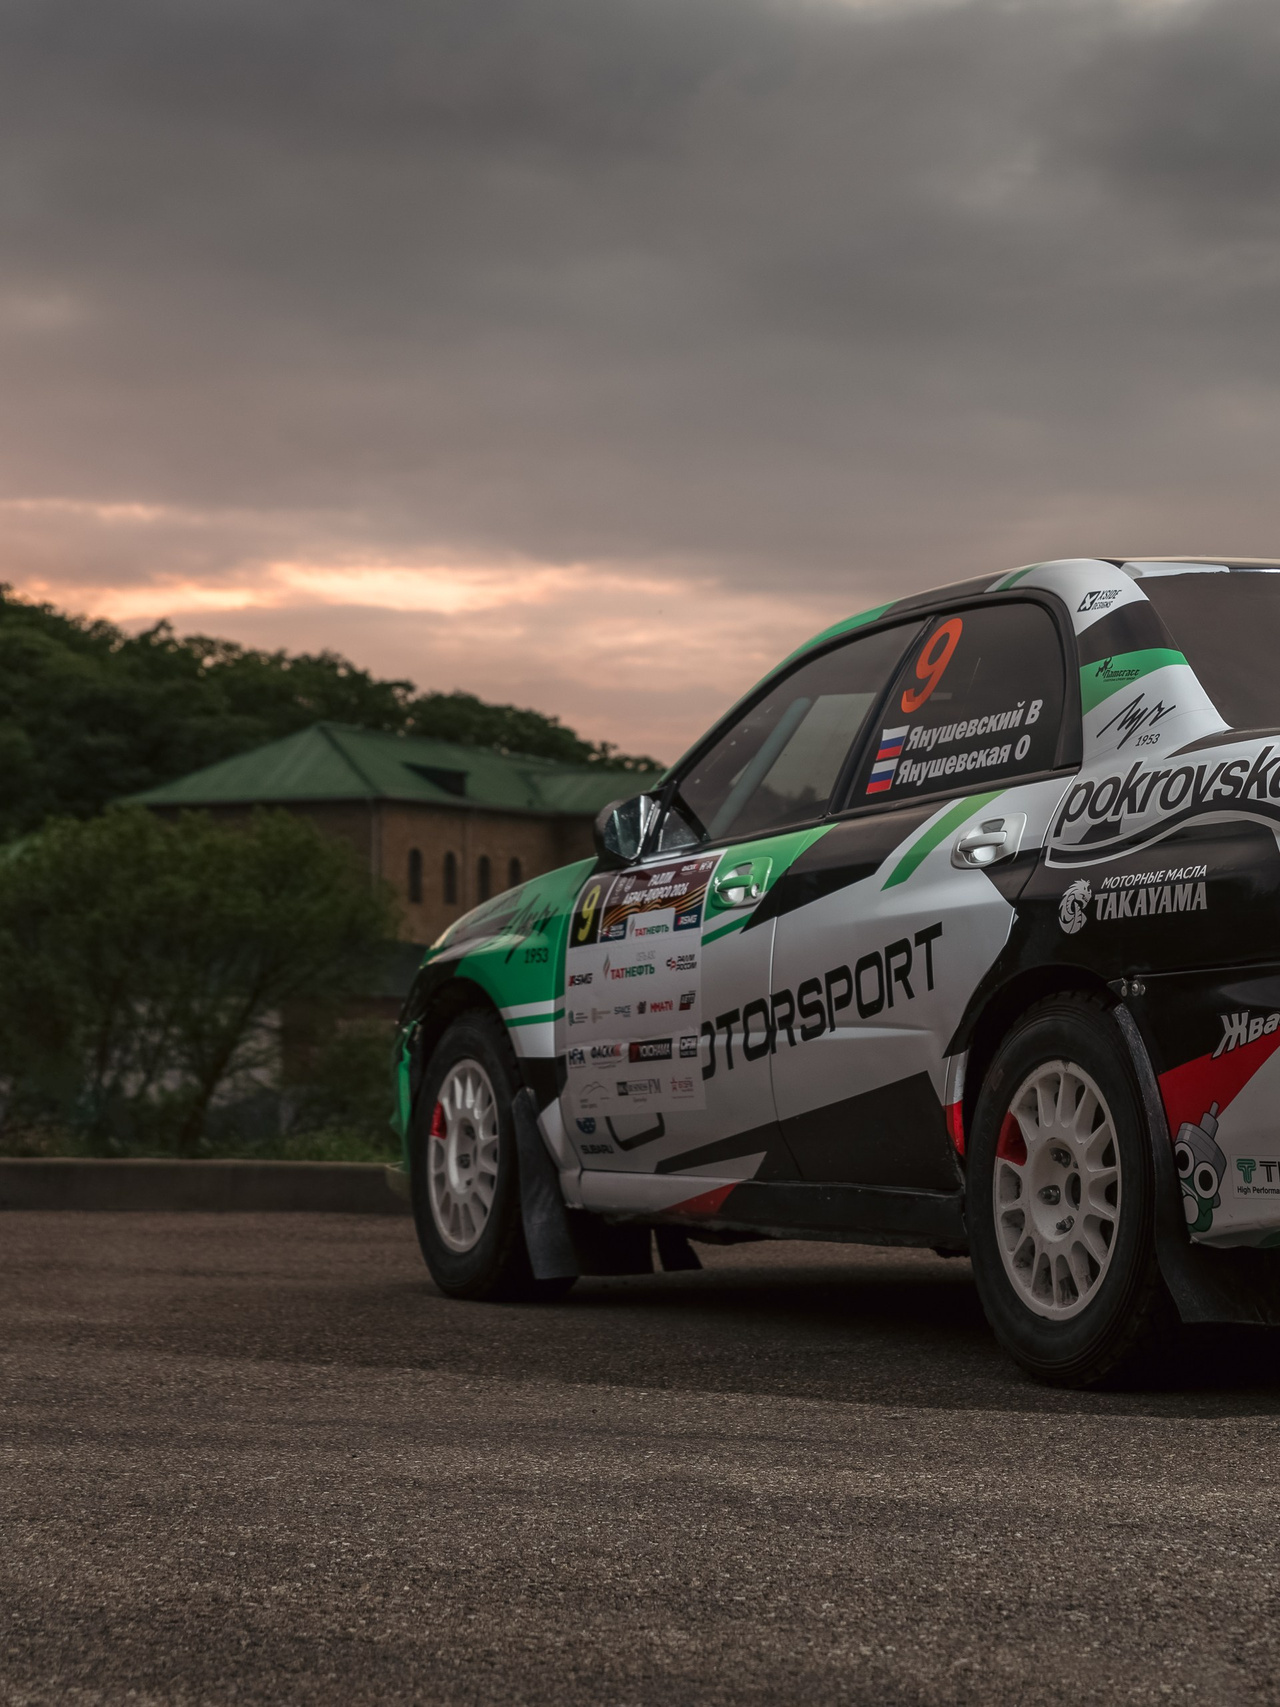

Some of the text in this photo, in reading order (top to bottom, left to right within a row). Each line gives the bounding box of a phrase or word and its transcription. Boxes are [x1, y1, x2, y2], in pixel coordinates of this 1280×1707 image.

[901, 617, 963, 714] 9
[905, 699, 1043, 752] Янушевский В
[1135, 733, 1160, 747] 1953
[895, 734, 1031, 786] Янушевская О
[1101, 864, 1208, 889] МОТОРНЫЕ МАСЛА
[1095, 881, 1208, 920] TAKAYAMA
[577, 884, 601, 942] 9
[635, 924, 669, 937] ТАТНЕФТЬ
[524, 947, 550, 964] 1953
[611, 963, 655, 980] ТАТНЕФТЬ
[580, 1144, 615, 1155] SUBARU
[1237, 1186, 1251, 1195] High
